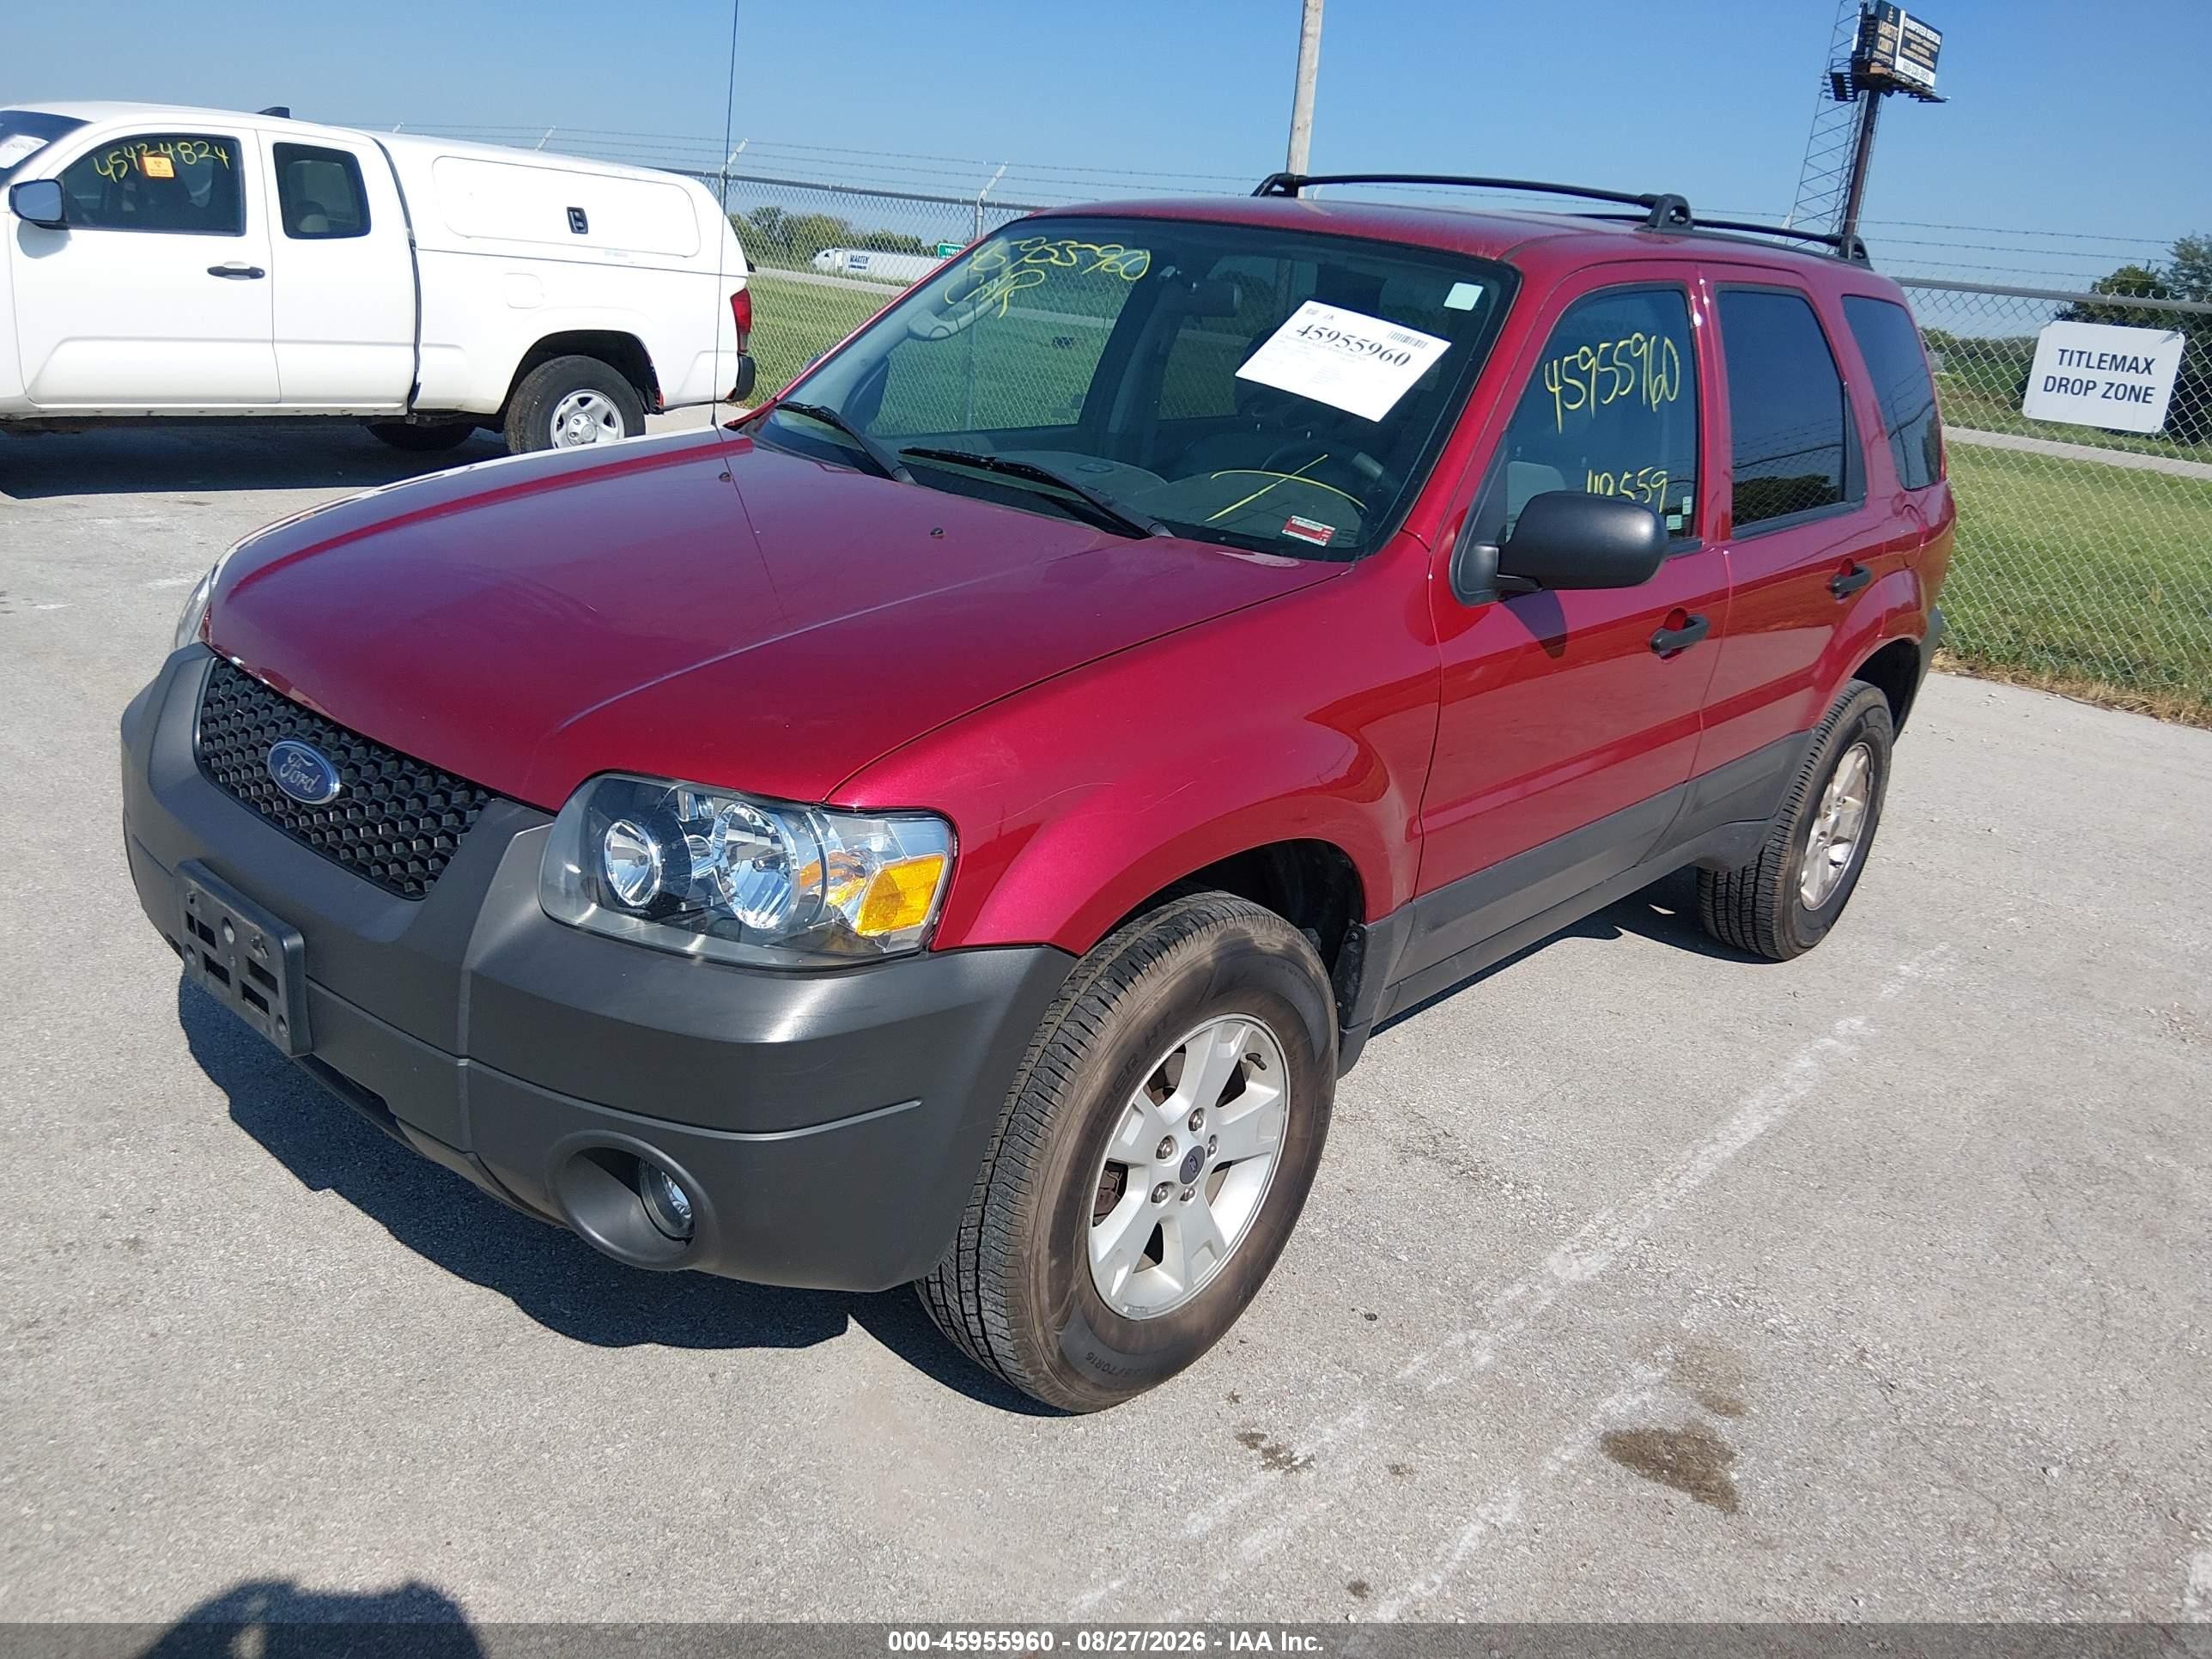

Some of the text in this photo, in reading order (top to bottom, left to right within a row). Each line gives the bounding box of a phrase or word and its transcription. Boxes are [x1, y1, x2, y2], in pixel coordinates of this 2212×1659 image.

[93, 141, 230, 183] 45424824
[1296, 324, 1411, 367] 45955960
[2058, 349, 2155, 375] TITLEMAX
[1544, 332, 1680, 434] 45955960
[2043, 375, 2155, 404] DROP ZONE
[280, 751, 322, 793] Ford
